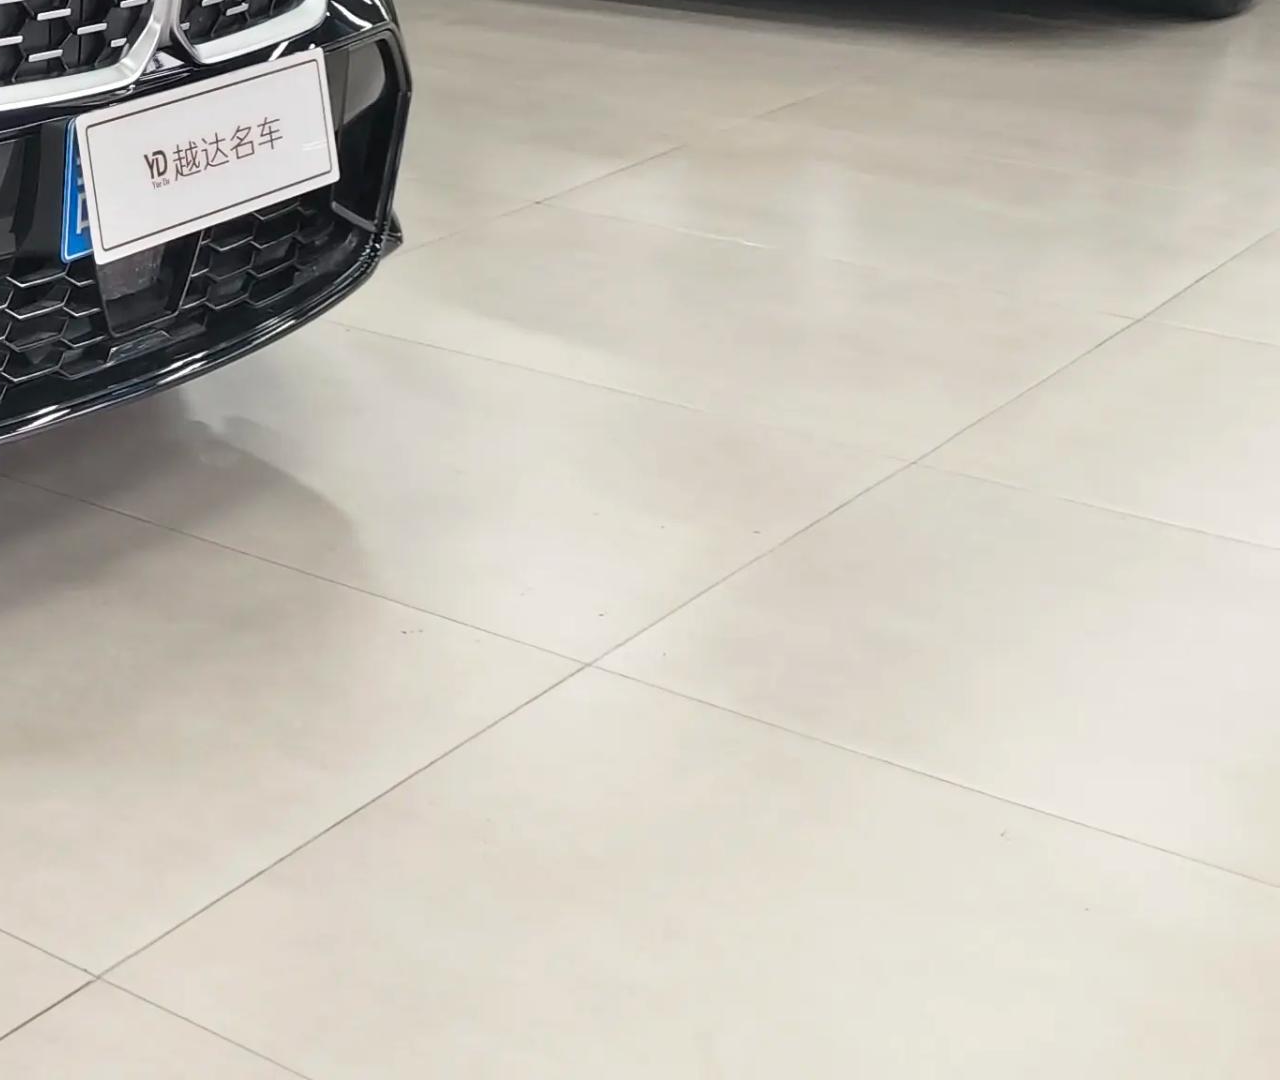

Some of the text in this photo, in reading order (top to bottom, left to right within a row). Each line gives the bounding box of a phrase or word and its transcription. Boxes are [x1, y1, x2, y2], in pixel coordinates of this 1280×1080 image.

[143, 116, 284, 182] YD 越达名车
